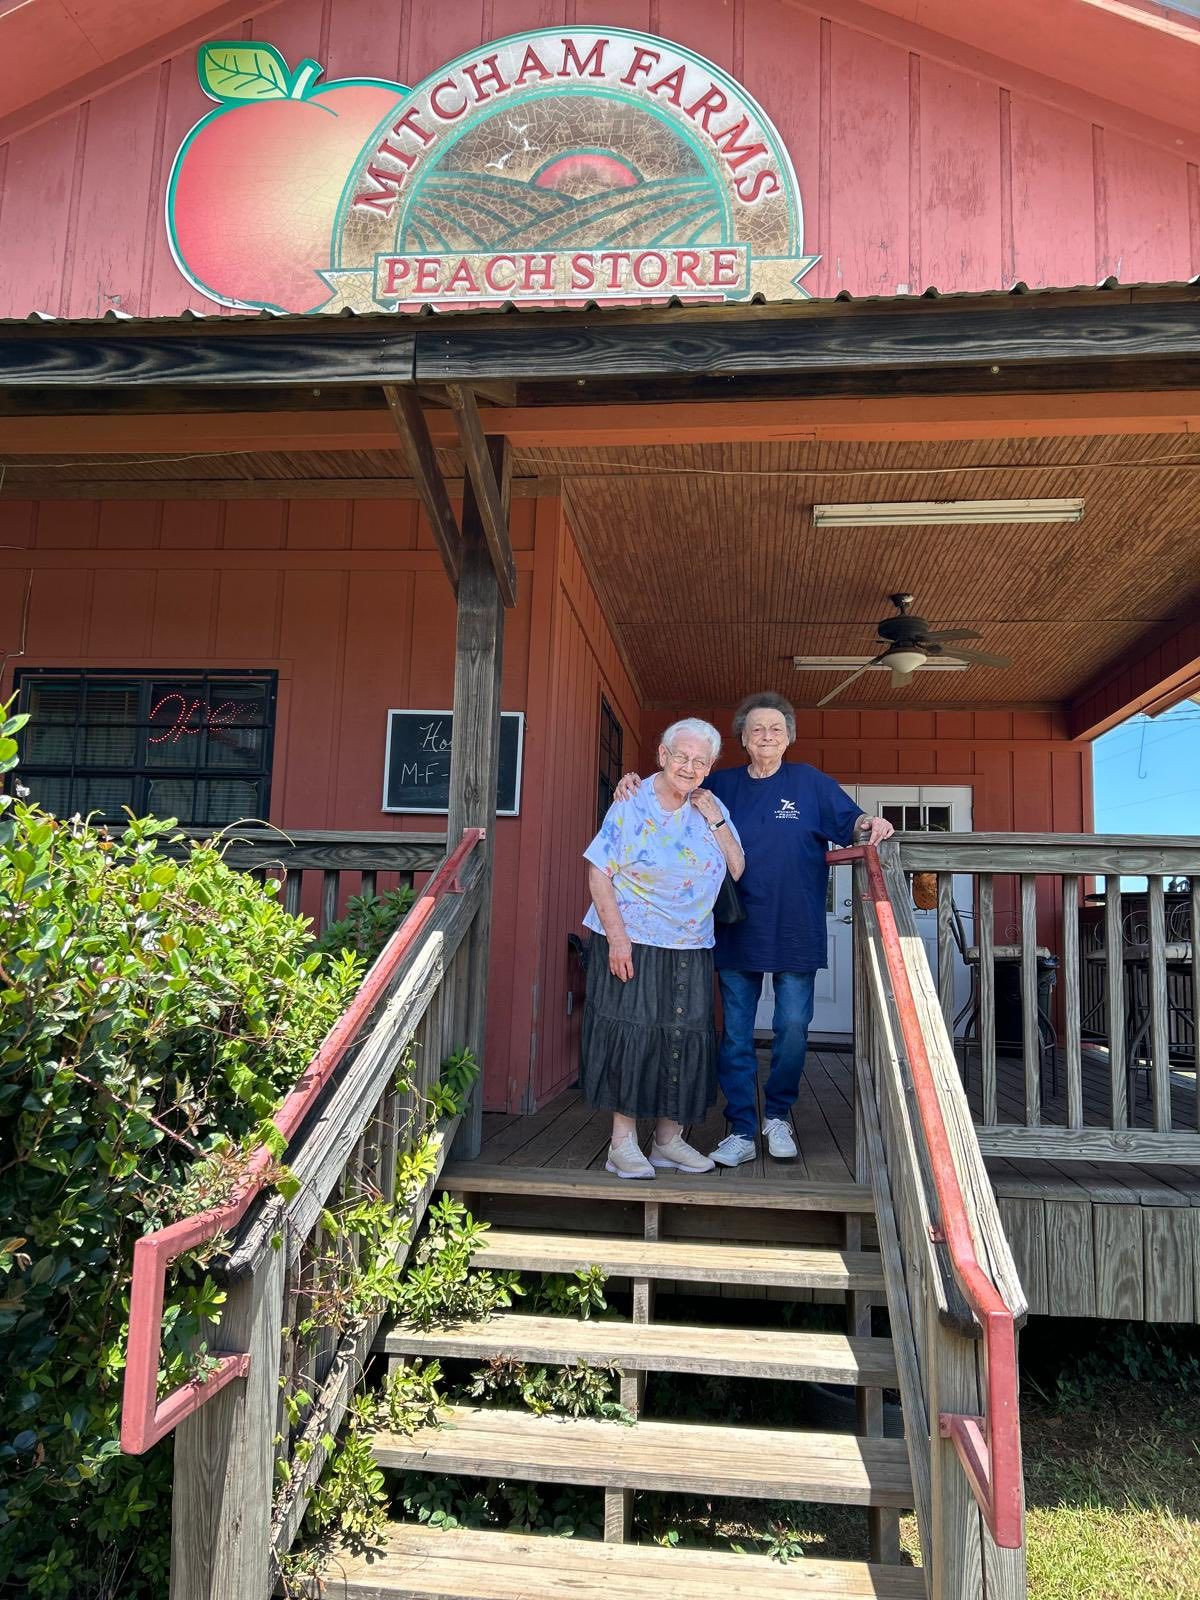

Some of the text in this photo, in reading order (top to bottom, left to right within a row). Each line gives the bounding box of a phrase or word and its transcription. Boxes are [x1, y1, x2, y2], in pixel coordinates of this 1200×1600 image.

[353, 38, 780, 217] MITCHAM FARMS
[382, 250, 740, 295] PEACH STORE
